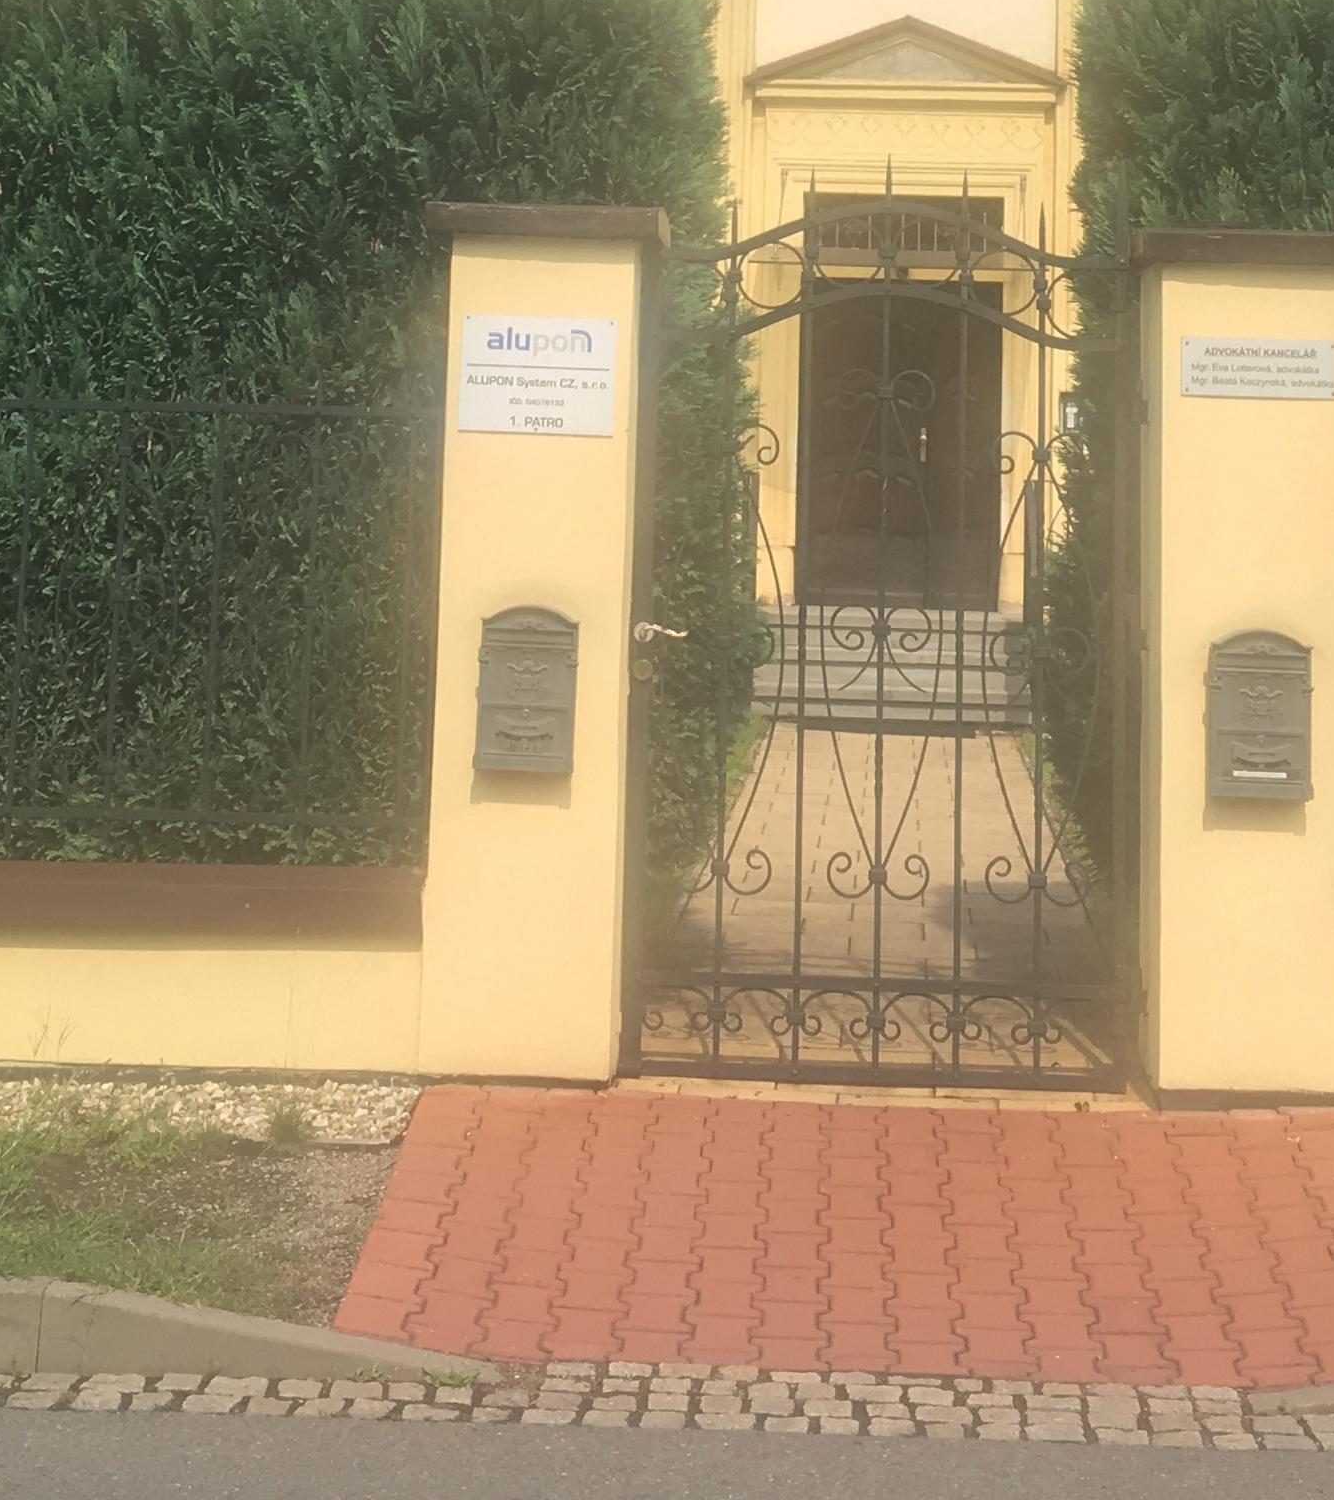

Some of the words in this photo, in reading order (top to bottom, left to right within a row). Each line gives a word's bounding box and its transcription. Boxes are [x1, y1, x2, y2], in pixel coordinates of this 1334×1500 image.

[486, 327, 592, 356] alupon
[1204, 346, 1261, 358] ADVOKÁTNÍ
[1263, 348, 1318, 359] KANCELÁŘ
[1212, 363, 1229, 372] Eva
[466, 374, 514, 387] ALUPON
[517, 377, 557, 390] System
[559, 378, 578, 390] CZ,
[524, 416, 564, 428] PATRO
